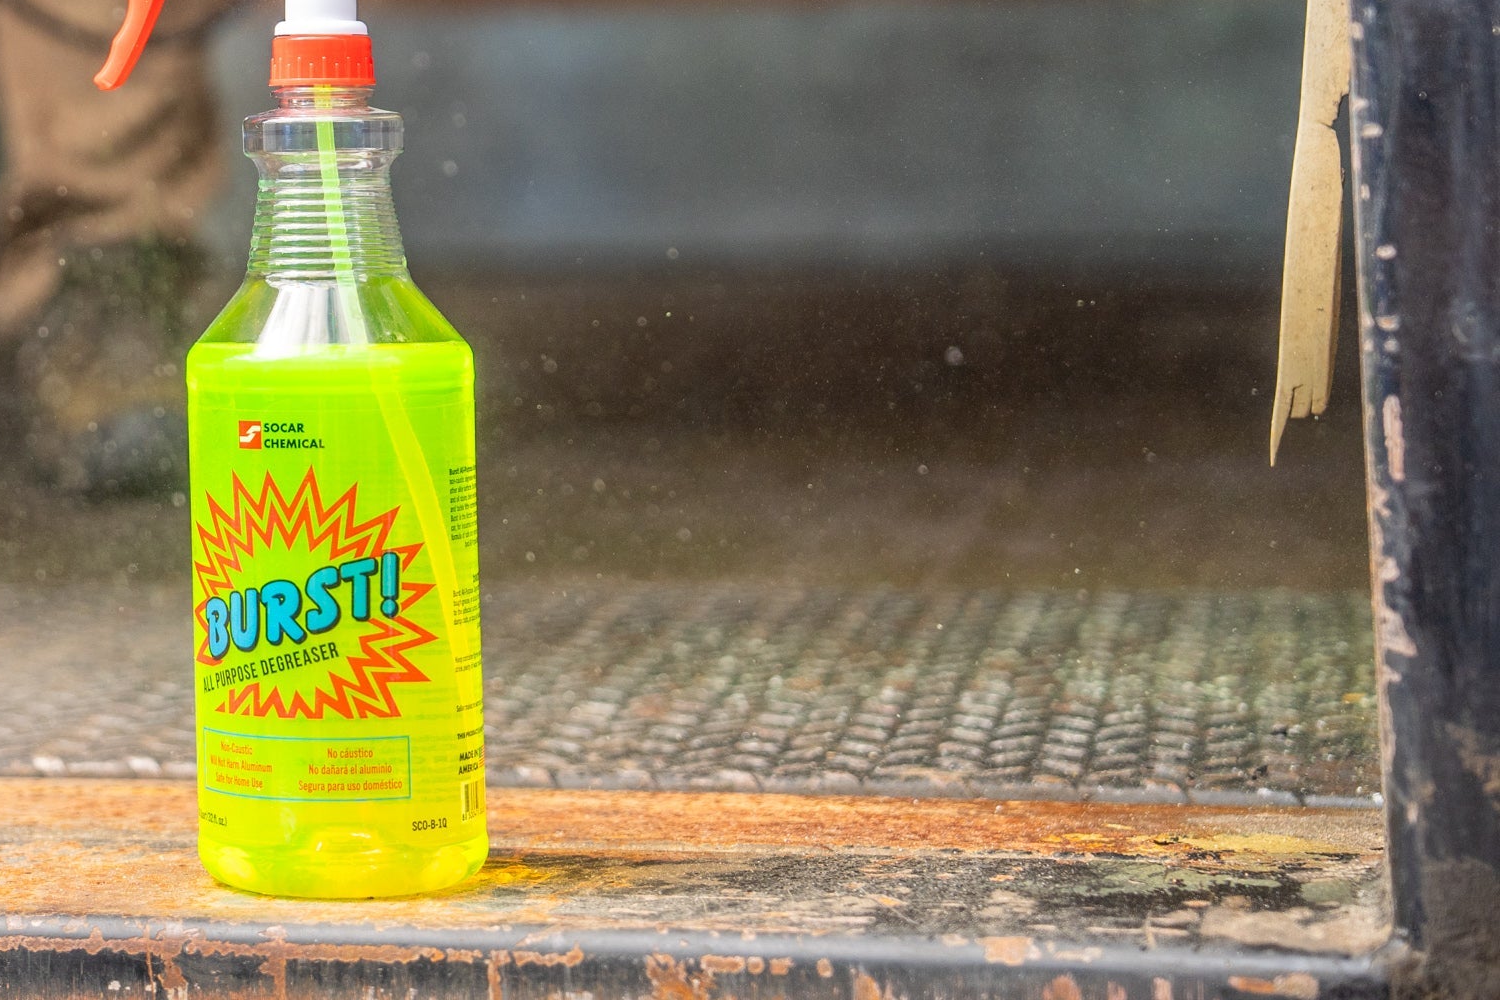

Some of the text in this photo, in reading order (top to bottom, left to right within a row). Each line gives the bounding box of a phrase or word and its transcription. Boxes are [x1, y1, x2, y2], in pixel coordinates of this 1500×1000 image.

[263, 422, 305, 433] SOCAR
[263, 438, 326, 449] CHEMICAL
[205, 551, 400, 661] BURST!
[203, 642, 340, 694] ALL PURPOSE DEGREASER
[327, 747, 374, 759] No cáustico
[459, 751, 474, 762] MADE
[241, 760, 273, 773] Aluminum
[308, 763, 319, 775] No
[350, 763, 358, 775] el
[359, 762, 393, 775] aluminio
[251, 777, 263, 789] Use
[298, 778, 403, 794] Segura para uso doméstico
